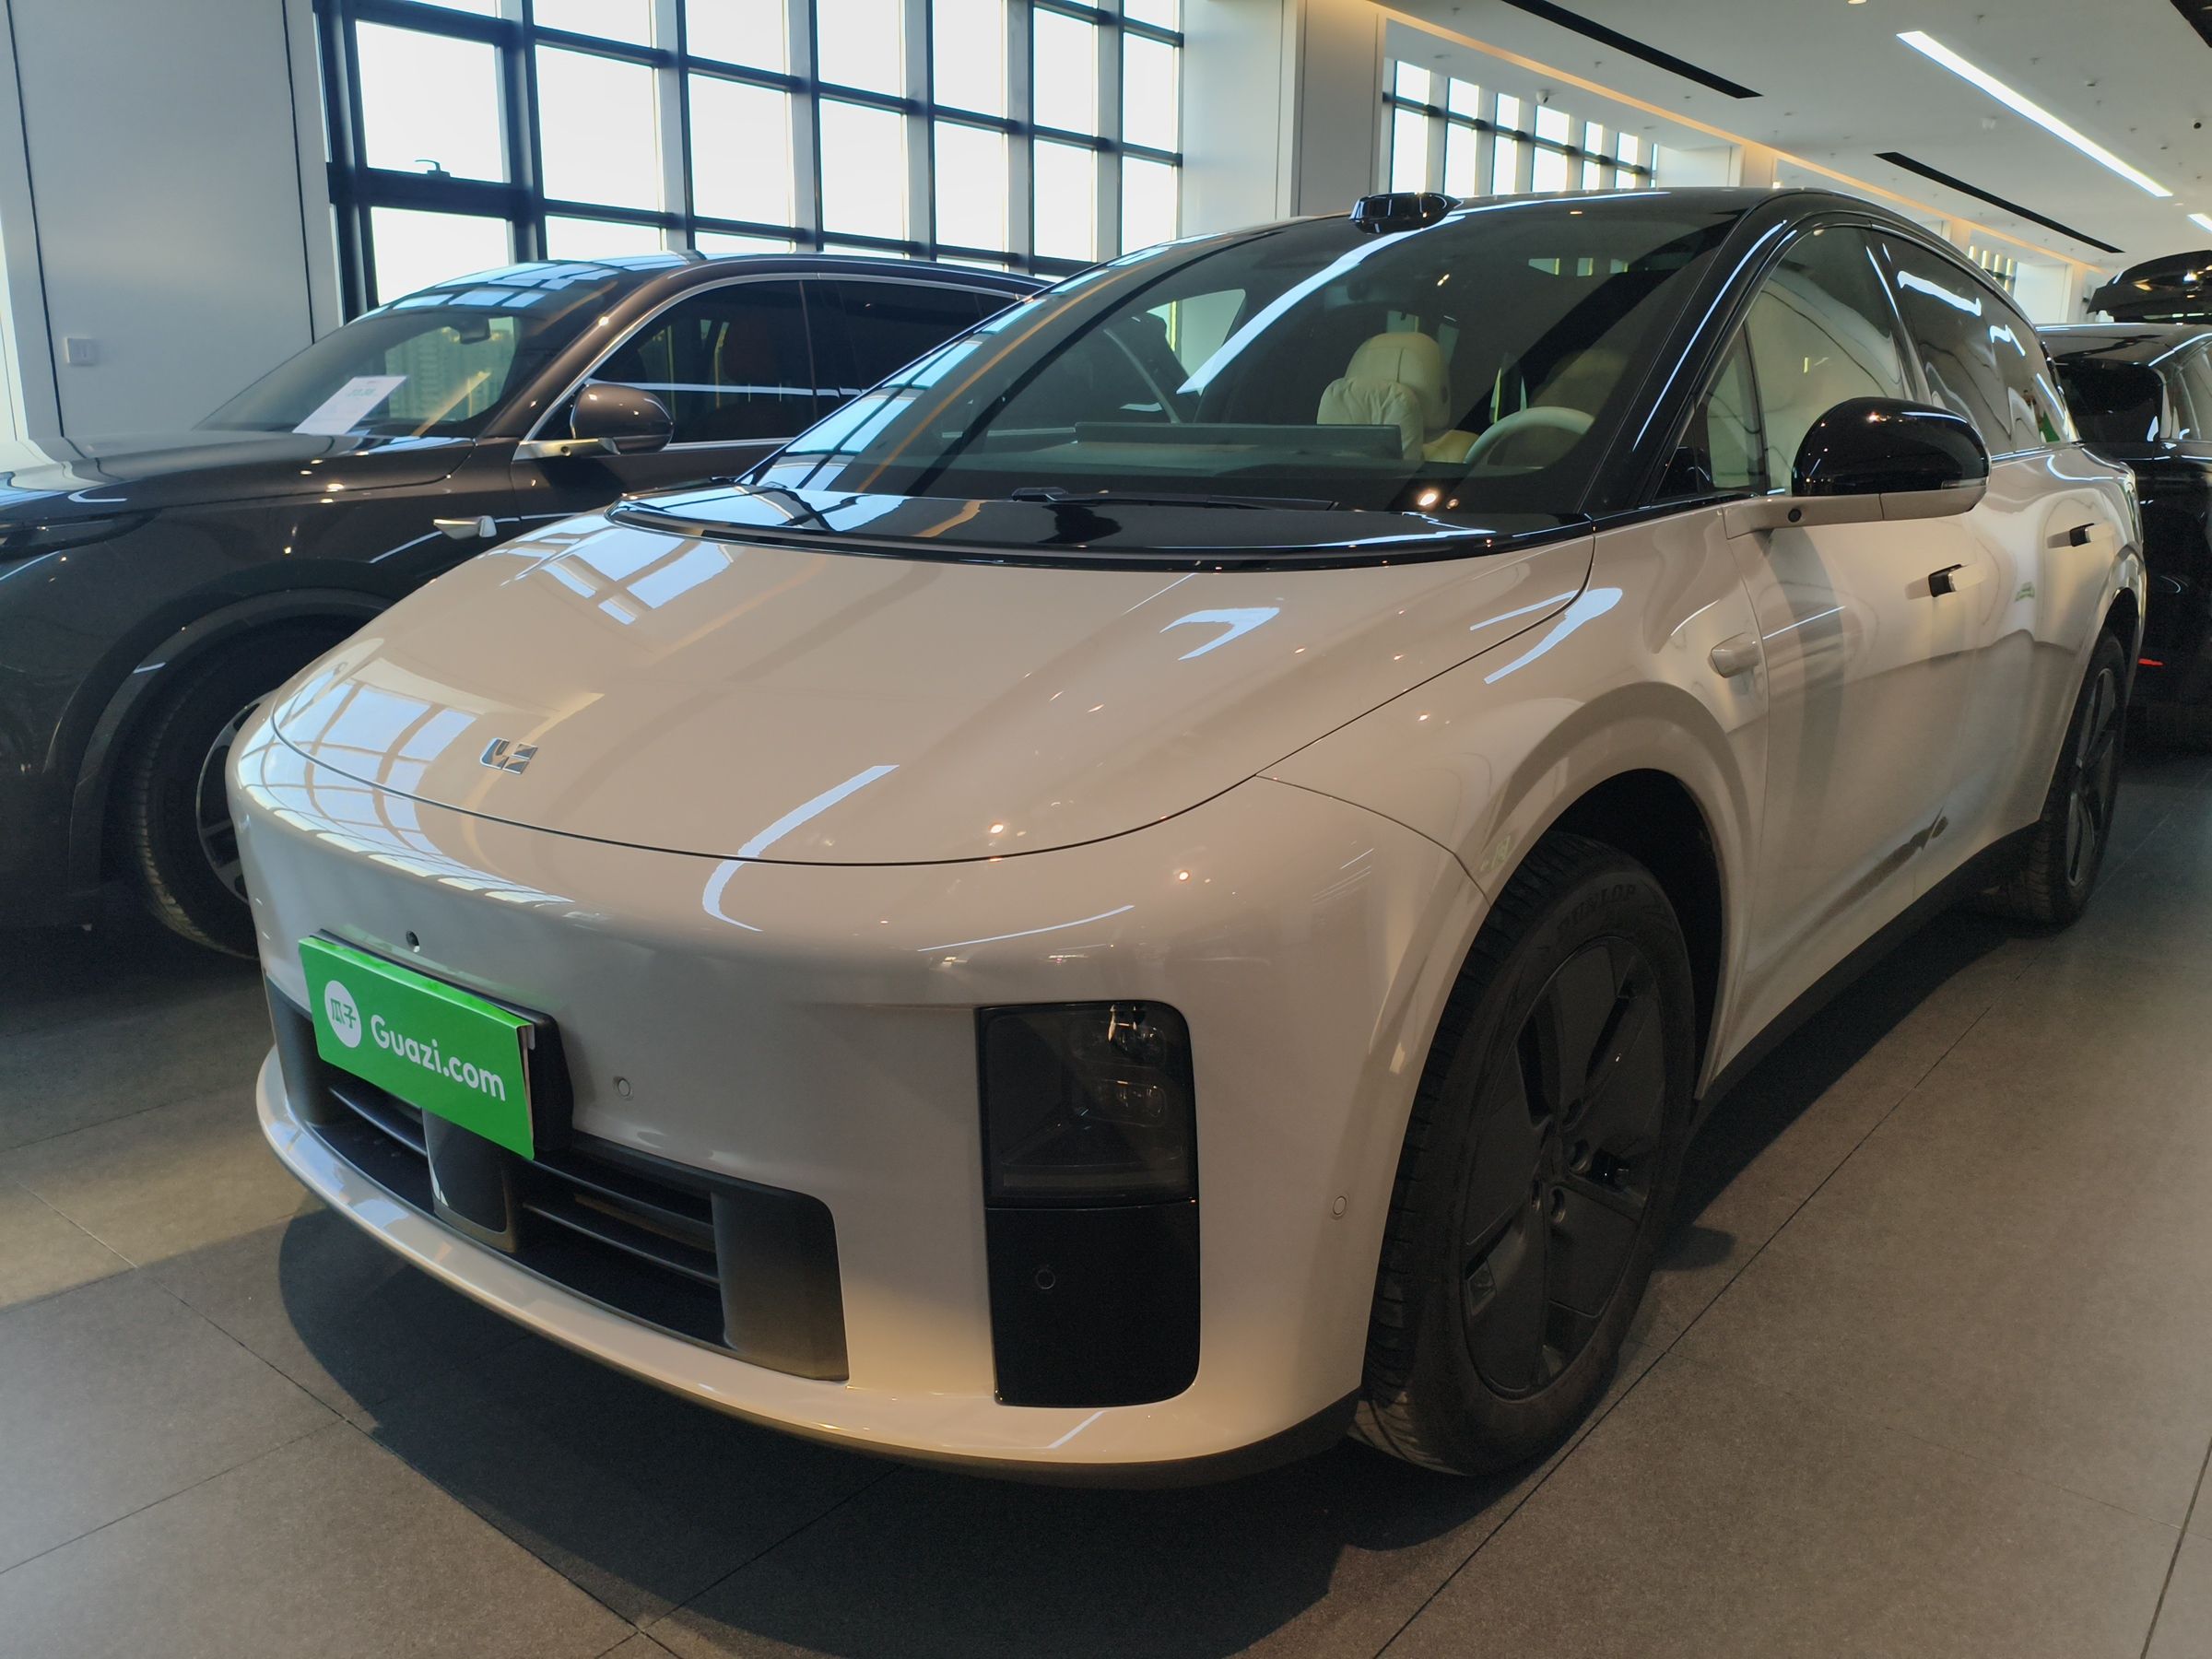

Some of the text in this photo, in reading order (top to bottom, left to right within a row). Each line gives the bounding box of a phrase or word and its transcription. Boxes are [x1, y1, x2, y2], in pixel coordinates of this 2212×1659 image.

[1556, 883, 1638, 933] DUNLOP
[330, 998, 357, 1030] 瓜子
[371, 1015, 506, 1101] Guazi.com
